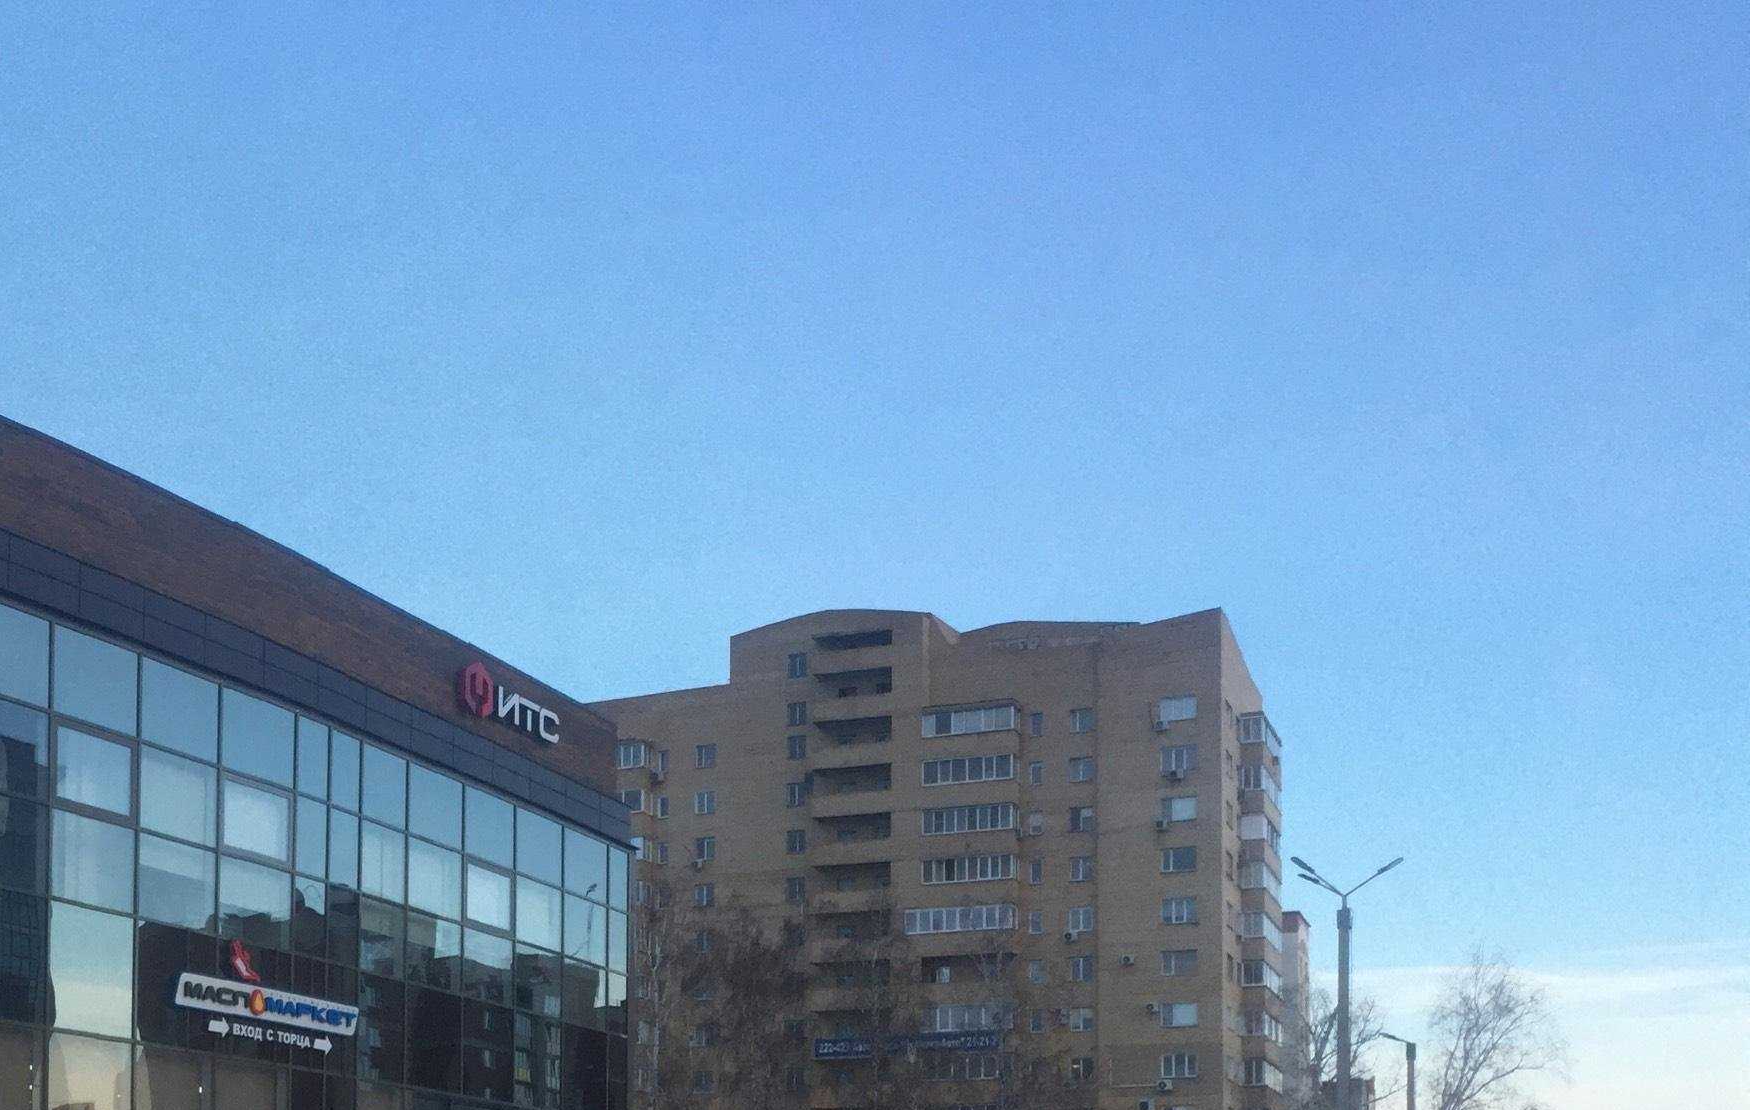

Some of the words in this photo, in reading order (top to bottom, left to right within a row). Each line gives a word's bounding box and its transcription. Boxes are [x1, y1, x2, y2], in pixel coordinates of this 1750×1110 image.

[498, 686, 560, 744] ИТС
[232, 1023, 263, 1041] ВХОД
[276, 1030, 311, 1048] ТОРЦА
